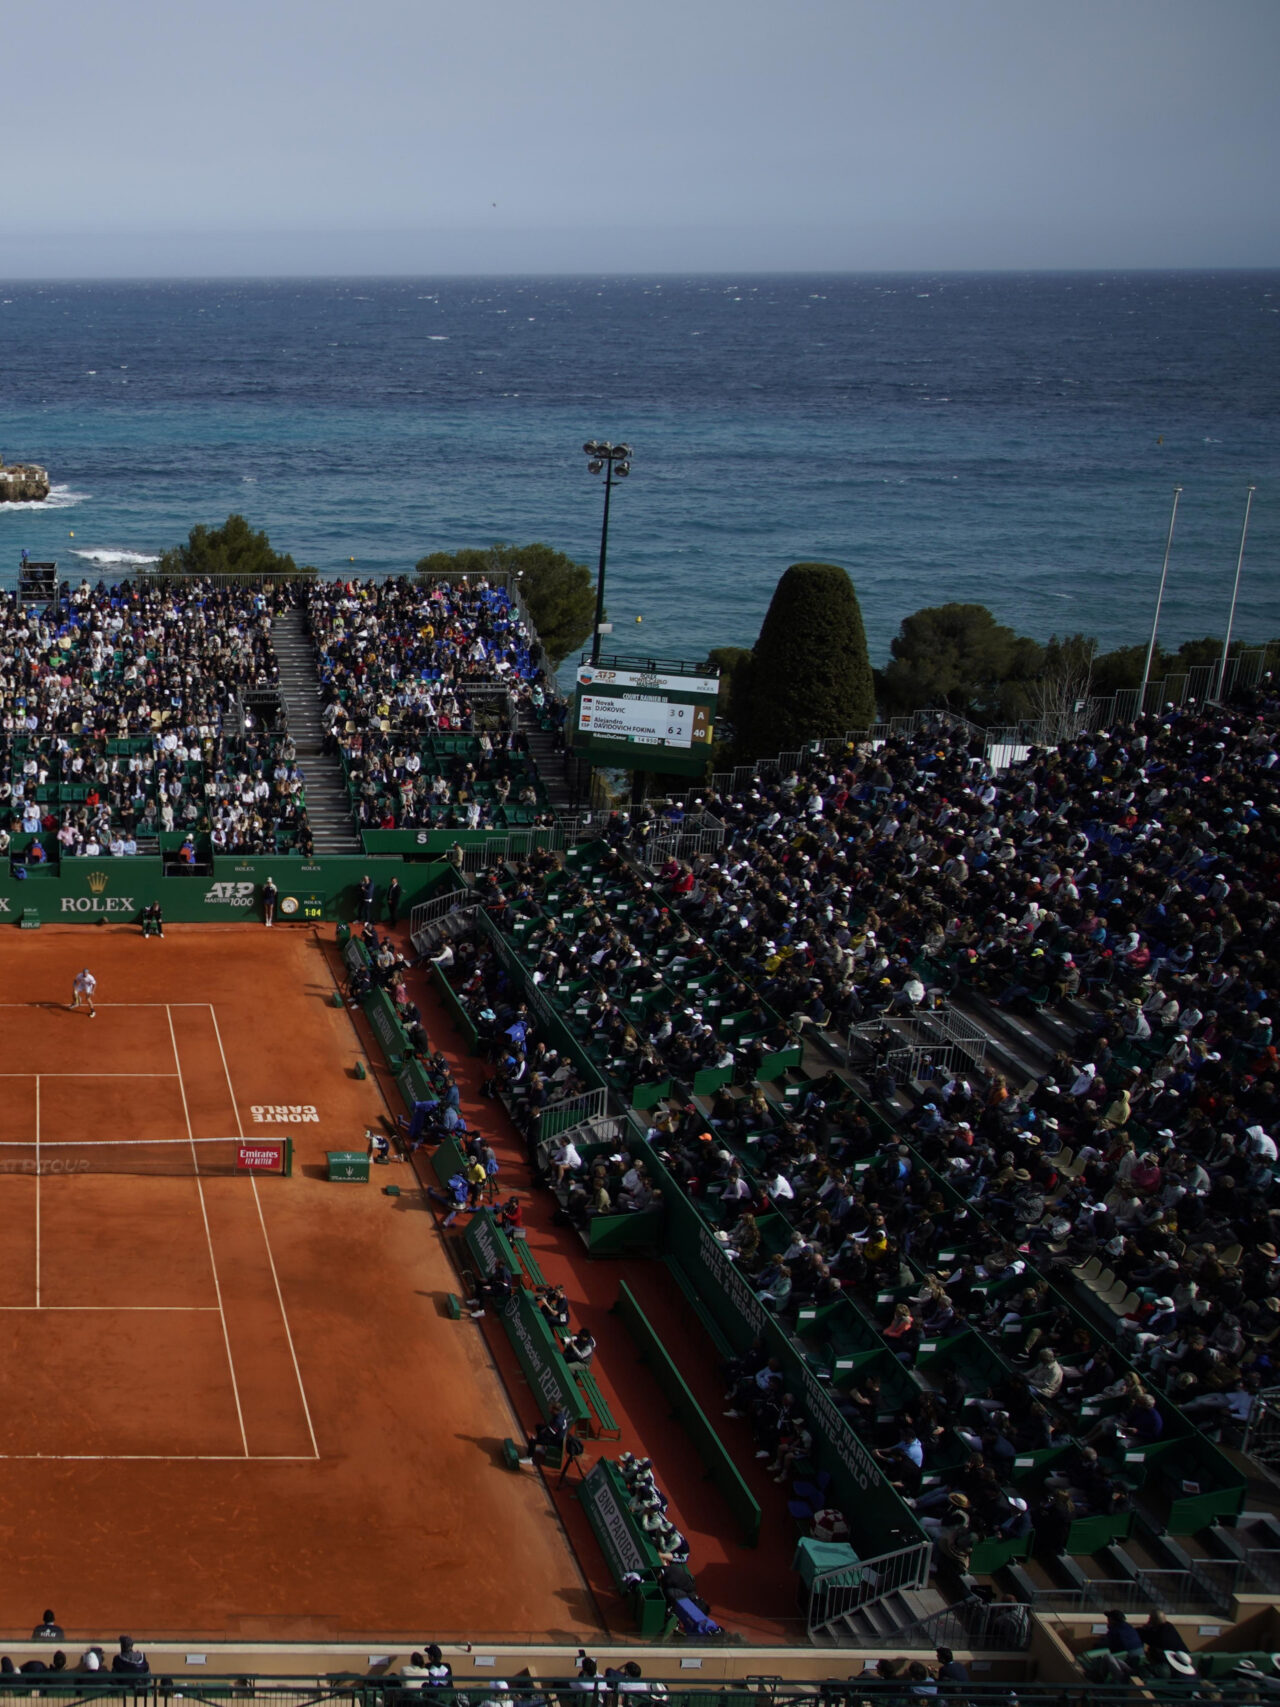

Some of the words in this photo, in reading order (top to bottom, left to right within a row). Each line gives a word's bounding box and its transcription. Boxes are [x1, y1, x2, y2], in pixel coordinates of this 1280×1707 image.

[595, 705, 626, 713] DJOKOVIC
[1074, 702, 1086, 712] F
[594, 716, 623, 725] Alejandro
[697, 711, 705, 720] A
[593, 723, 632, 732] DAVIDOVICH
[693, 729, 705, 738] 40
[417, 833, 427, 844] S
[204, 882, 255, 898] ATP
[61, 898, 135, 912] ROLEX
[230, 897, 254, 906] 1000
[304, 908, 322, 917] 1:04
[250, 1105, 317, 1114] CARLO
[253, 1114, 320, 1123] MONTE
[240, 1149, 279, 1158] Emirates
[40, 1159, 90, 1172] TOUR
[700, 1245, 722, 1284] HOTEL
[731, 1289, 762, 1337] RESORT
[751, 1295, 767, 1327] BAY
[511, 1312, 527, 1341] Sergio
[523, 1331, 544, 1374] Tacchini
[801, 1367, 842, 1432] THERMES
[842, 1427, 881, 1487] MARINS
[806, 1391, 868, 1491] MONTE-CARLO
[597, 1488, 615, 1515] BNP
[609, 1513, 640, 1573] PARIBAS
